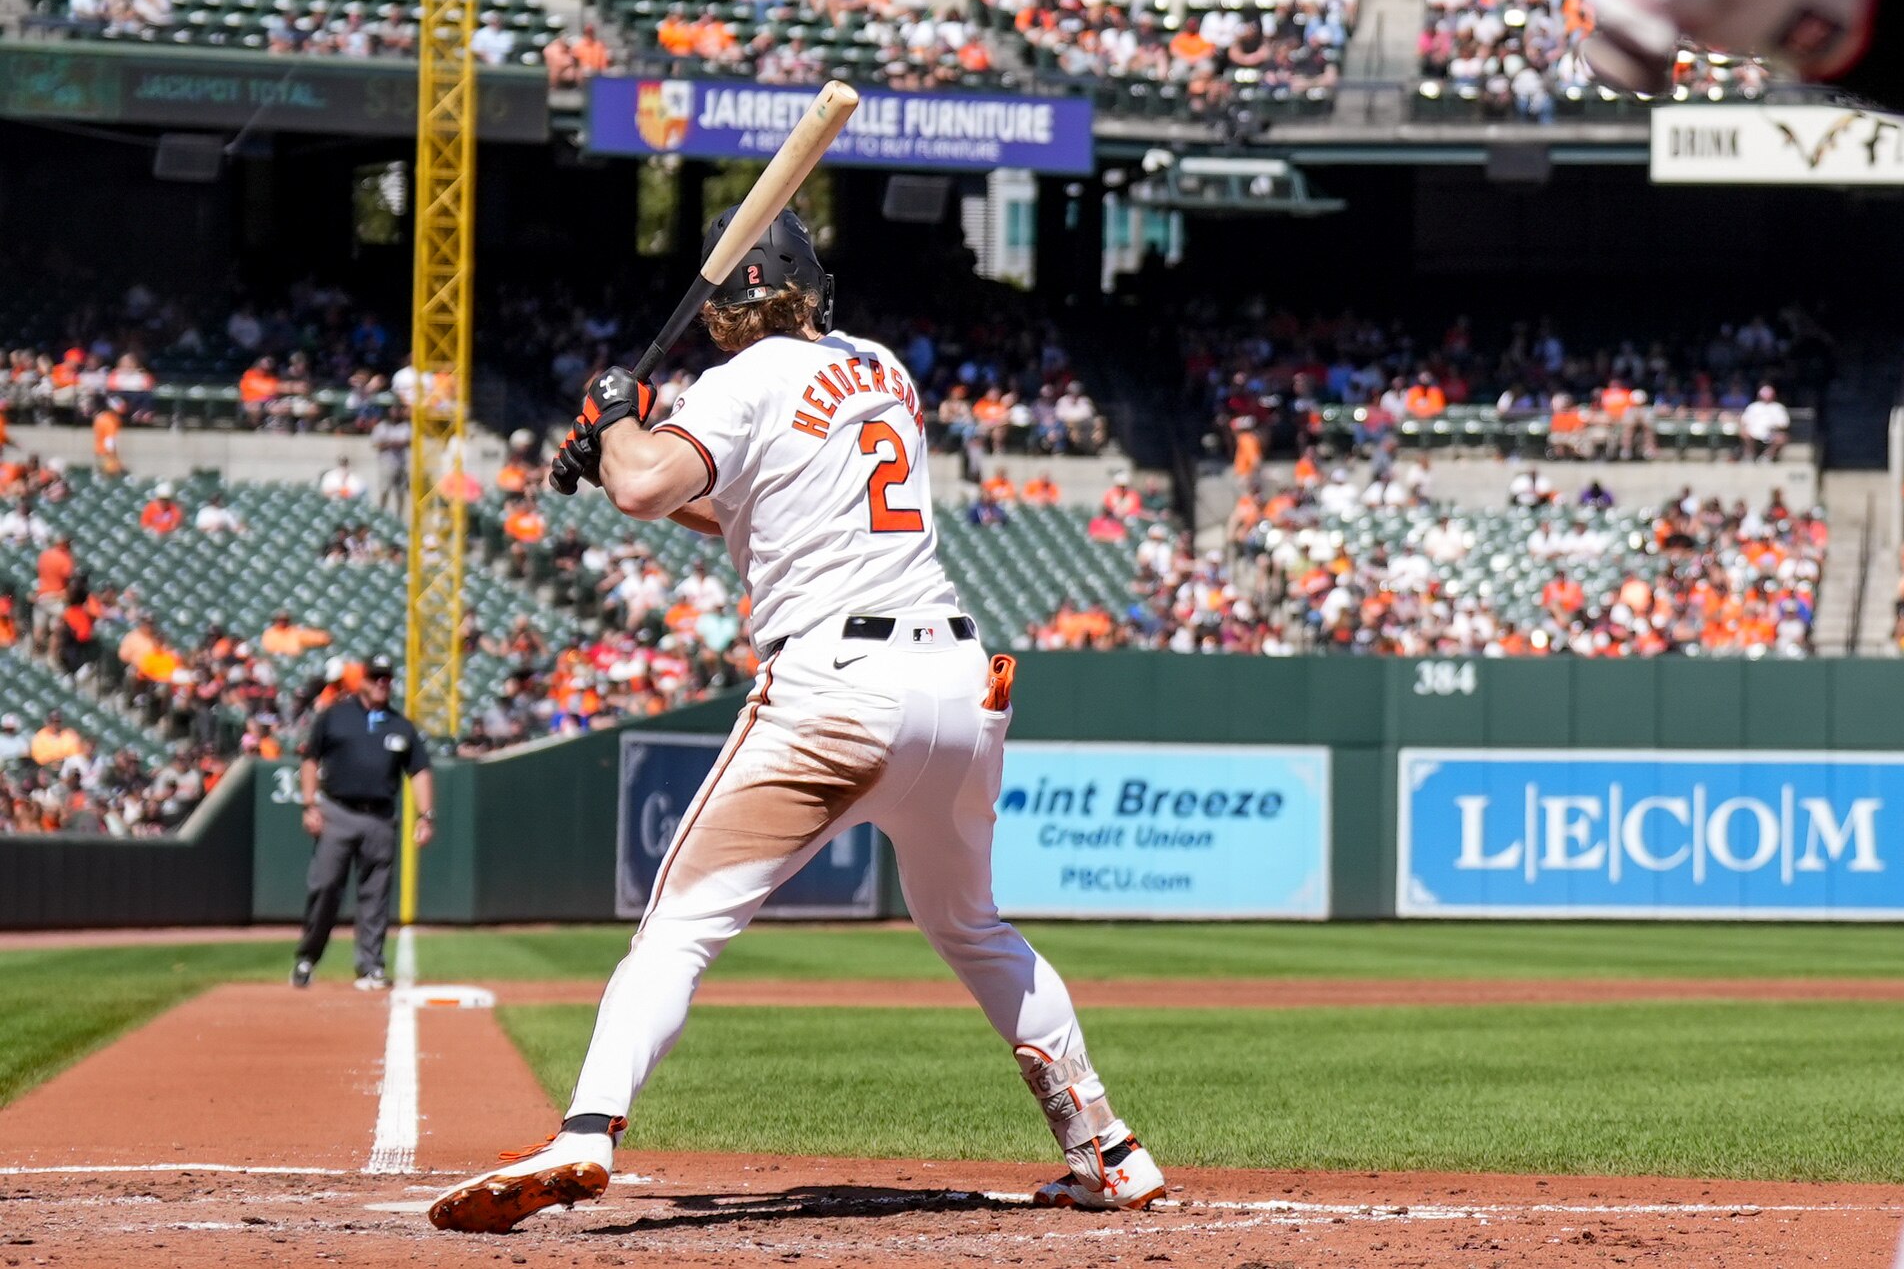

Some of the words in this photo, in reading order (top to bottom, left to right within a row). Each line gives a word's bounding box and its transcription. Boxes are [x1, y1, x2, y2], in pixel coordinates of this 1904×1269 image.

[904, 99, 1054, 145] FURNITURE
[1669, 126, 1740, 158] DRINK
[747, 265, 760, 285] 2
[858, 419, 925, 534] 2
[1413, 659, 1479, 696] 384
[1114, 778, 1285, 819] Breeze
[1038, 822, 1125, 849] Credit
[1135, 823, 1215, 850] Union
[1060, 865, 1193, 892] PBCU.com
